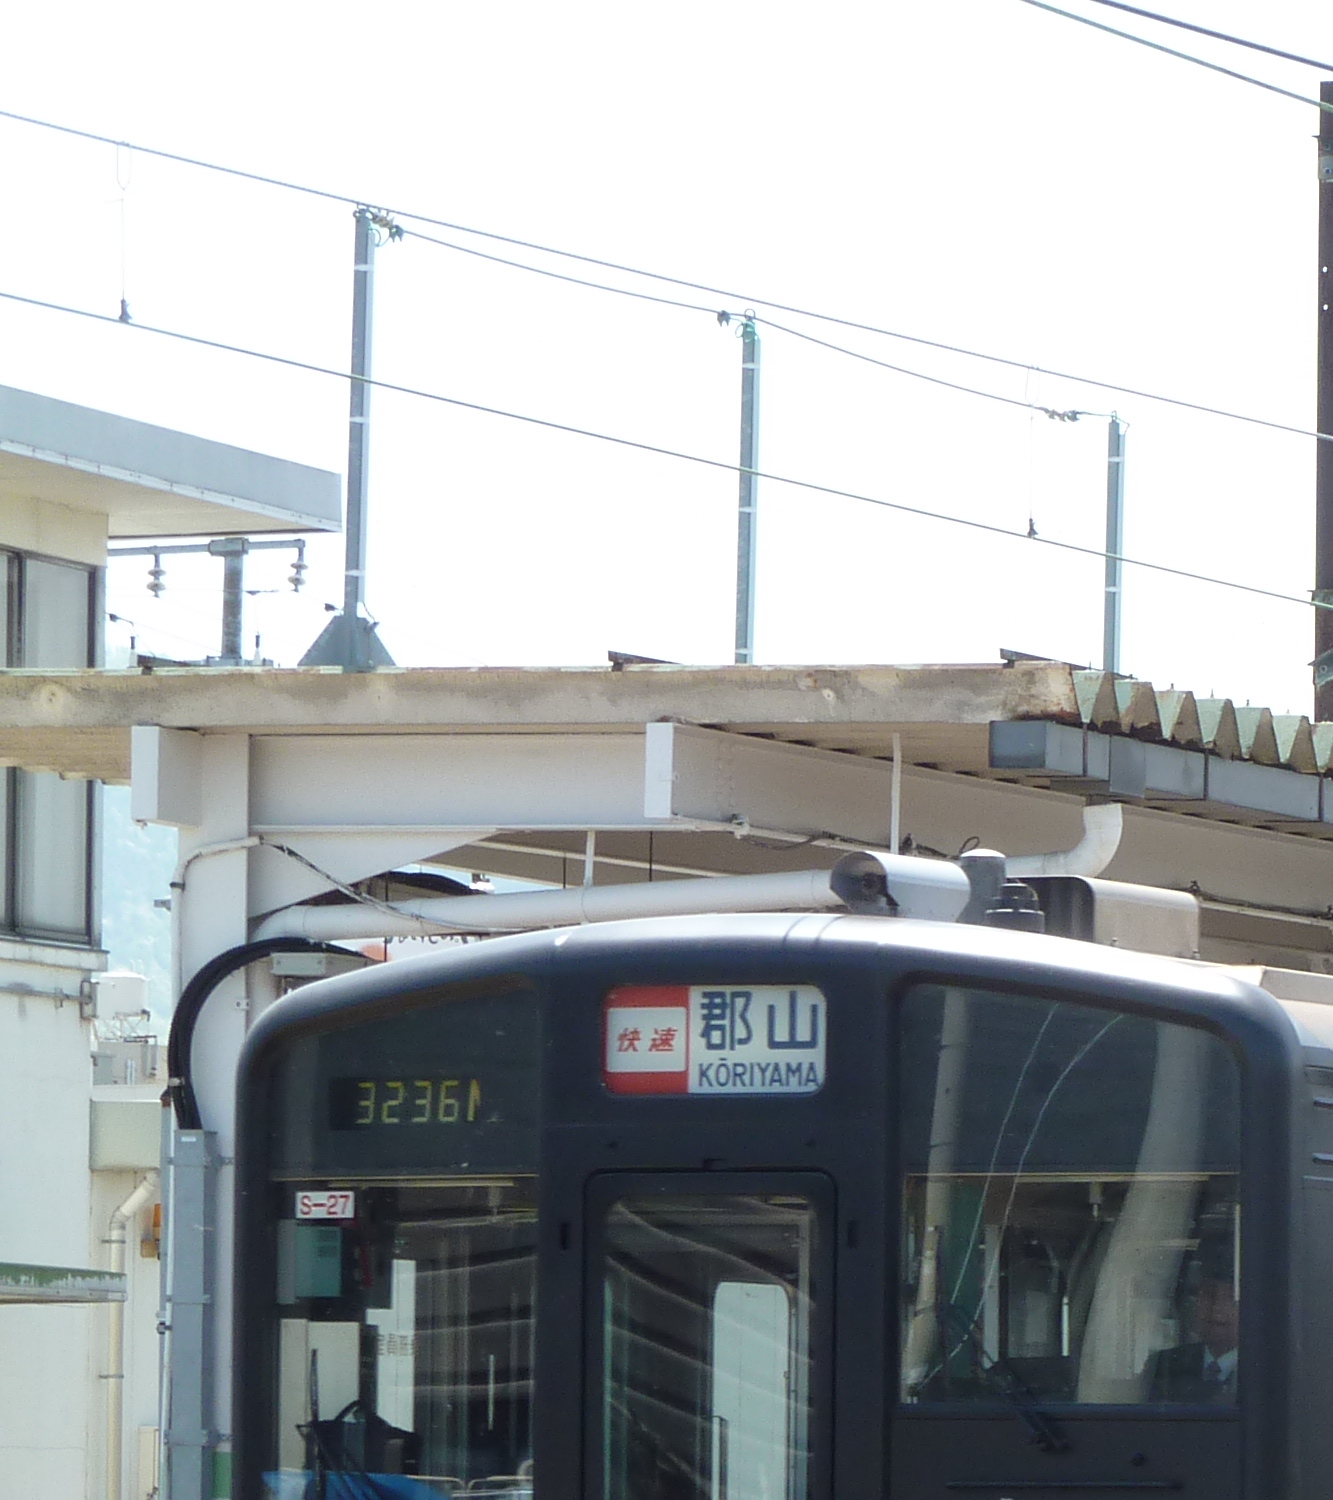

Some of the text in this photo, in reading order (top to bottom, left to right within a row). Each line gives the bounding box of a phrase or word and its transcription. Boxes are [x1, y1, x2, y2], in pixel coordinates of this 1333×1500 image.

[616, 989, 819, 1054] 快速 郡山
[698, 1057, 820, 1088] KŌRIYAMA
[299, 1194, 350, 1216] S-27
